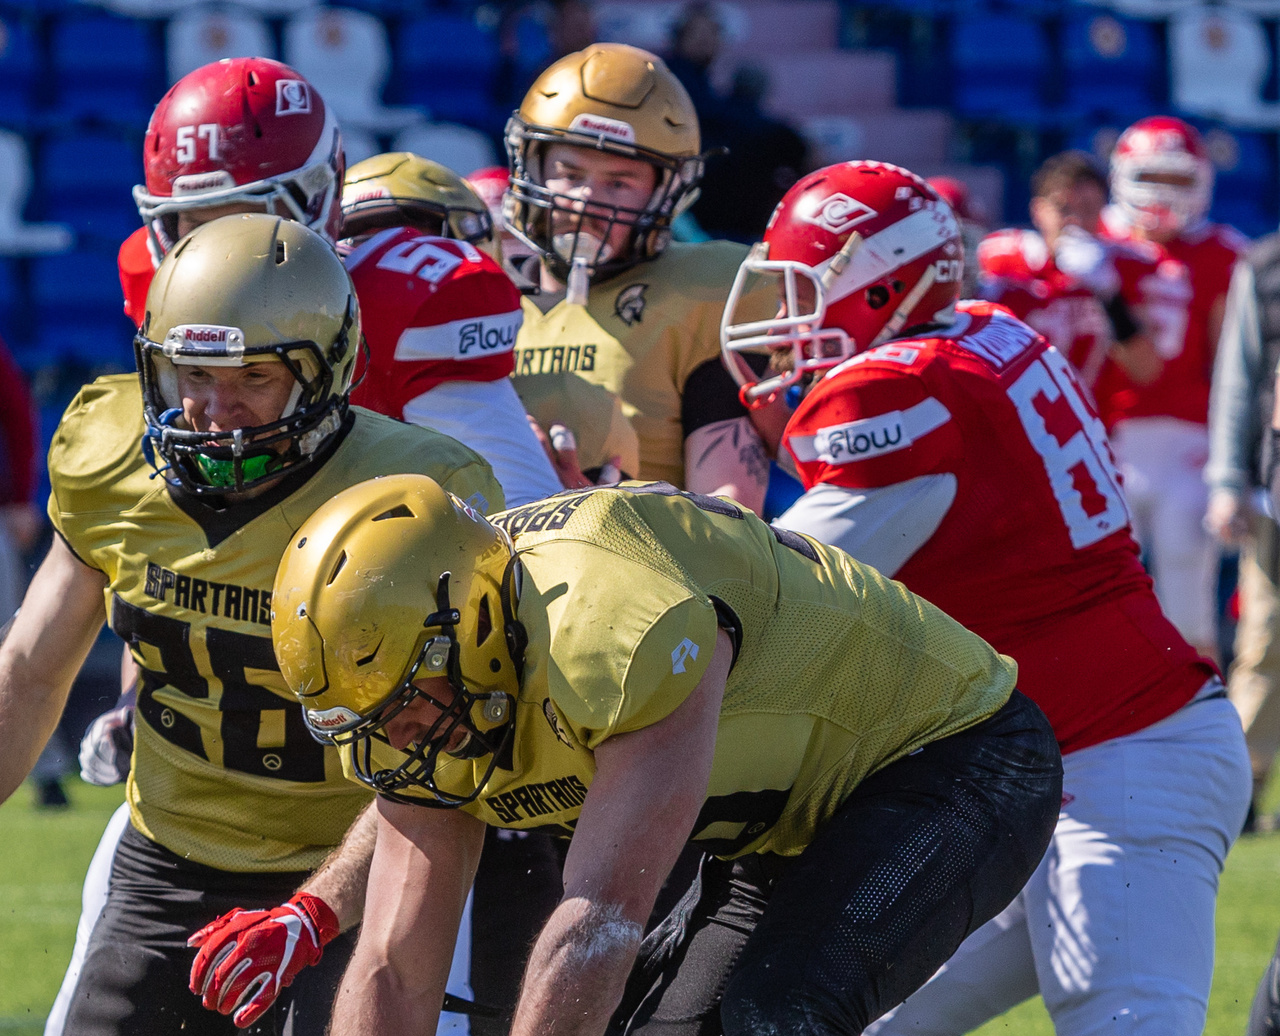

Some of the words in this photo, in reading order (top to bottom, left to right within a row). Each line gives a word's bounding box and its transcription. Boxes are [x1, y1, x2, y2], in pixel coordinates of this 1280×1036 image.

[176, 123, 219, 165] 57
[185, 329, 226, 342] Riddell
[144, 562, 272, 625] SPARTANS
[485, 775, 588, 824] SPARTANS
